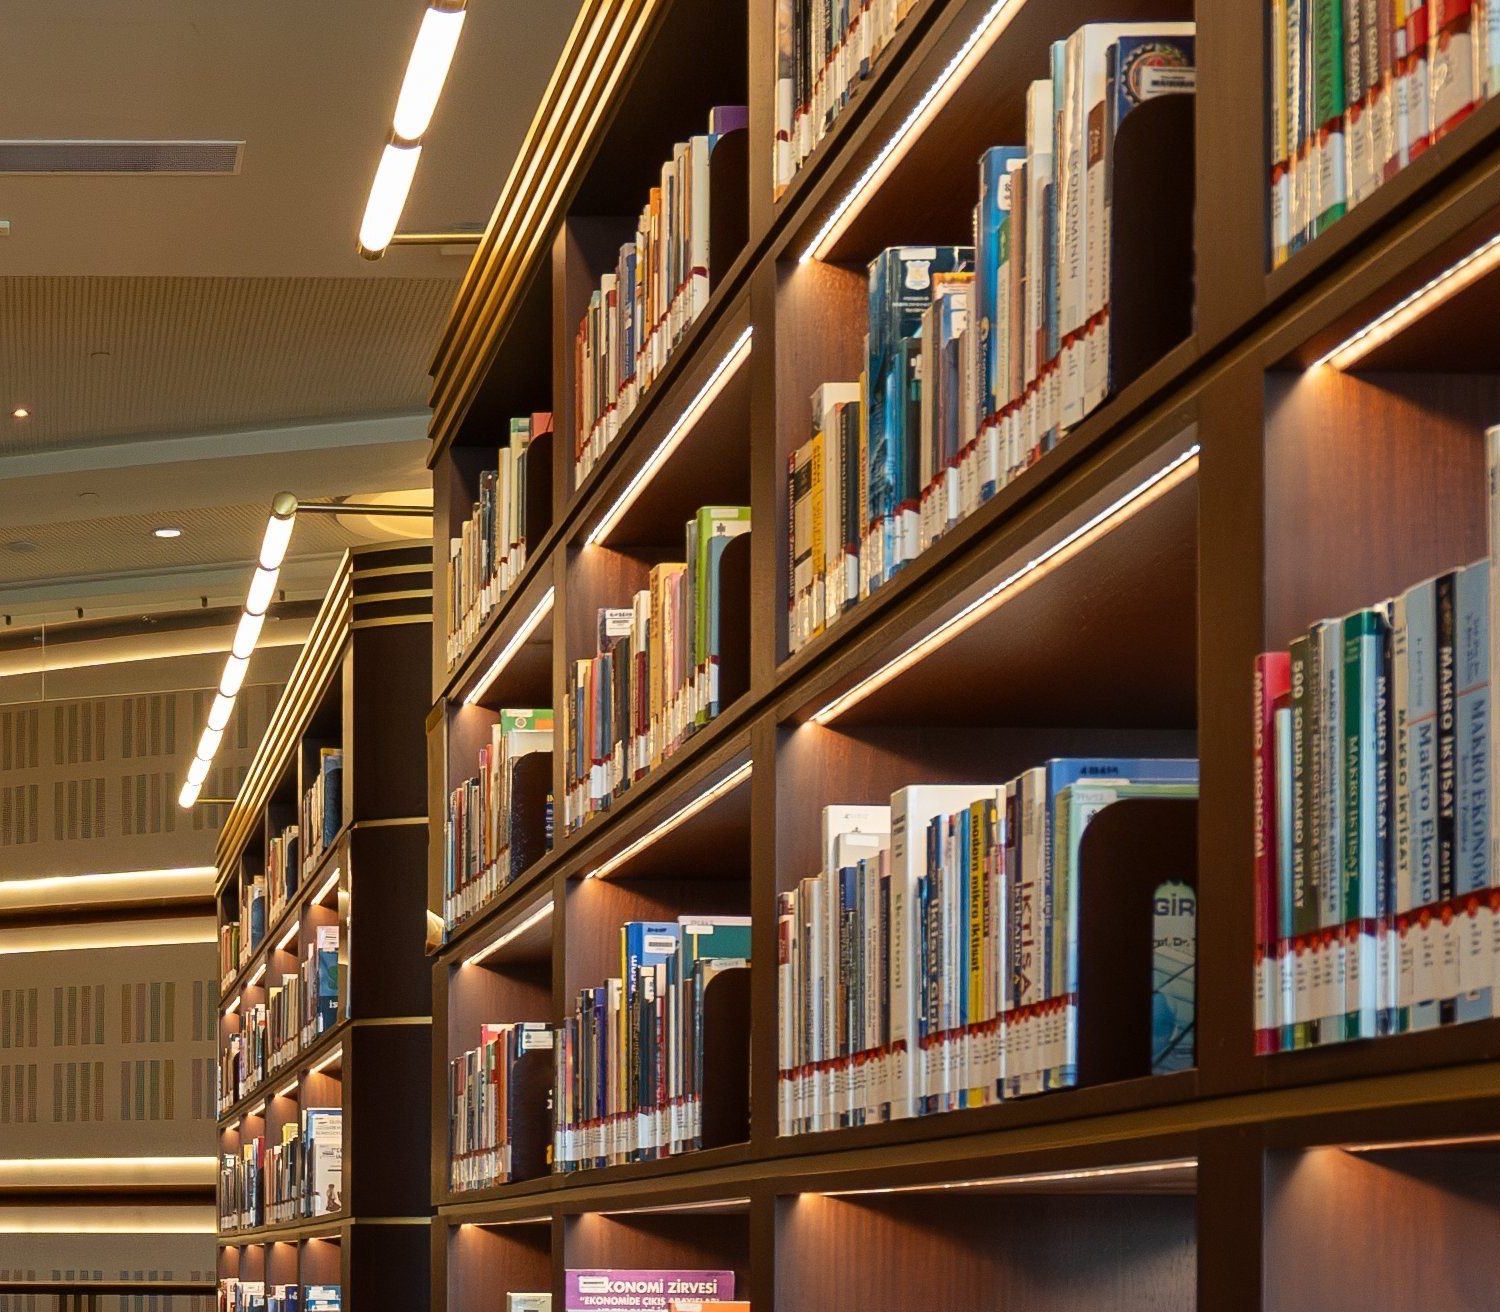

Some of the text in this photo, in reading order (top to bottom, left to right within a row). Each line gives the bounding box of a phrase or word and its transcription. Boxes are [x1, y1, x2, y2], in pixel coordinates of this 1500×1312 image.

[1256, 671, 1266, 858] MAKRO EKONOMİ
[1292, 659, 1305, 908] 500 SORUDA MAKRO İKTİSAT
[1348, 735, 1360, 879] MAKRO İKTİSAT
[1376, 676, 1390, 840] MAKRO İKTİSAT
[1397, 709, 1411, 872] MAKRO İKTİSAT
[1418, 723, 1435, 901] Makro Ekono
[1440, 646, 1456, 818] MAKRO İKTİSAT
[1470, 699, 1487, 889] MAKRO EKONOM
[971, 814, 980, 974] modern mikro iktisat
[604, 1279, 717, 1296] KONOMİ ZİRVESİ
[642, 1297, 666, 1309] ÇIKIŞ
